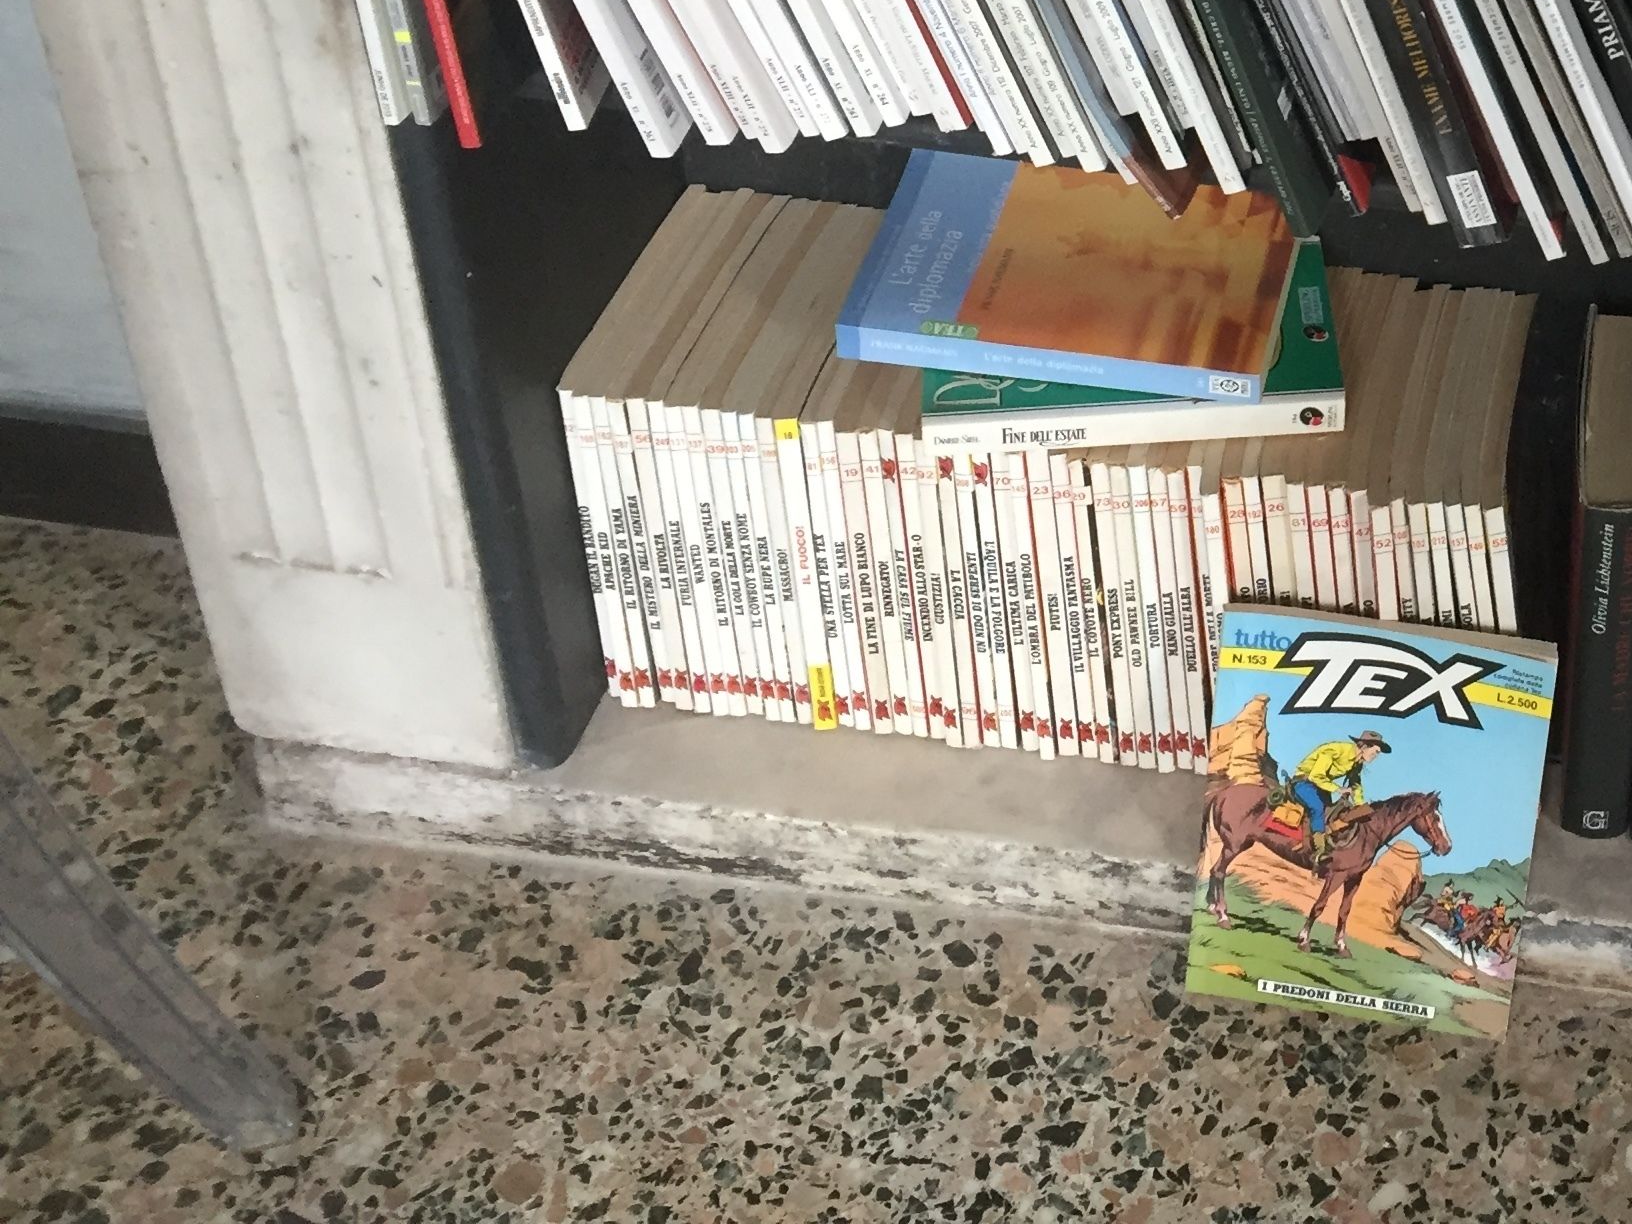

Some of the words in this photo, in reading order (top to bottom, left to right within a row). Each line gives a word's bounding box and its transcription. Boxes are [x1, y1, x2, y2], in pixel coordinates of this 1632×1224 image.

[1420, 80, 1454, 136] EXAME
[907, 229, 963, 316] diplomazia
[1047, 359, 1104, 375] diplomazia
[1002, 427, 1026, 444] FINE
[1055, 427, 1087, 441] ESTATE
[1033, 486, 1049, 495] 23
[1268, 503, 1285, 513] 26
[627, 495, 641, 537] MINIERA
[700, 502, 717, 555] MONTALES
[736, 513, 750, 542] NOME
[597, 532, 610, 555] KID
[669, 521, 688, 576] INFERNALE
[721, 521, 735, 549] MORTE
[757, 536, 770, 562] NERA
[796, 526, 809, 570] FUOCO!
[854, 532, 869, 571] BIANCO
[636, 542, 649, 571] DELLA
[653, 534, 670, 574] RIVOLTA
[690, 544, 706, 583] WANTED
[739, 545, 755, 574] SENZA
[835, 541, 847, 569] MARE
[1596, 523, 1616, 595] Lichtenstein
[600, 556, 616, 591] APACHE
[620, 553, 636, 598] RITORNO
[662, 577, 672, 589] LA
[761, 565, 774, 590] RUPE
[857, 572, 872, 599] LUPO
[878, 561, 895, 617] RINNEGATO!
[966, 552, 981, 598] SERPENTI
[1005, 561, 1018, 593] CARICA
[1020, 553, 1035, 595] PATIBOLO
[1063, 555, 1079, 606] FANTASMA
[1123, 579, 1136, 603] BILL
[642, 576, 658, 619] MISTERO
[678, 580, 692, 606] FURIA
[712, 571, 728, 615] RITORNO
[745, 577, 761, 617] COWBOY
[839, 596, 854, 624] LOTTA
[930, 573, 945, 624] GIUSTIZIA!
[951, 585, 965, 620] CACCIA
[1107, 588, 1121, 627] EXPRESS
[1162, 591, 1175, 626] GIALLA
[1180, 586, 1195, 635] ALL'ALBA
[992, 608, 1006, 654] FOLGORE
[1084, 608, 1099, 645] COYOTE
[1126, 607, 1140, 646] PAWNEE
[1146, 603, 1161, 649] TORTURA
[1591, 595, 1608, 635] Olivia
[1068, 609, 1084, 662] VILLAGGIO
[1111, 628, 1124, 659] PONY
[1166, 628, 1179, 657] MANO
[1235, 628, 1292, 652] tutto
[1130, 648, 1142, 668] OLD
[1185, 636, 1198, 673] DUELLO
[1284, 636, 1499, 726] TEX
[1262, 982, 1268, 991] I
[1273, 983, 1331, 1001] PREDONI
[1335, 993, 1377, 1008] DELLA
[1382, 1001, 1429, 1017] SIERRA
